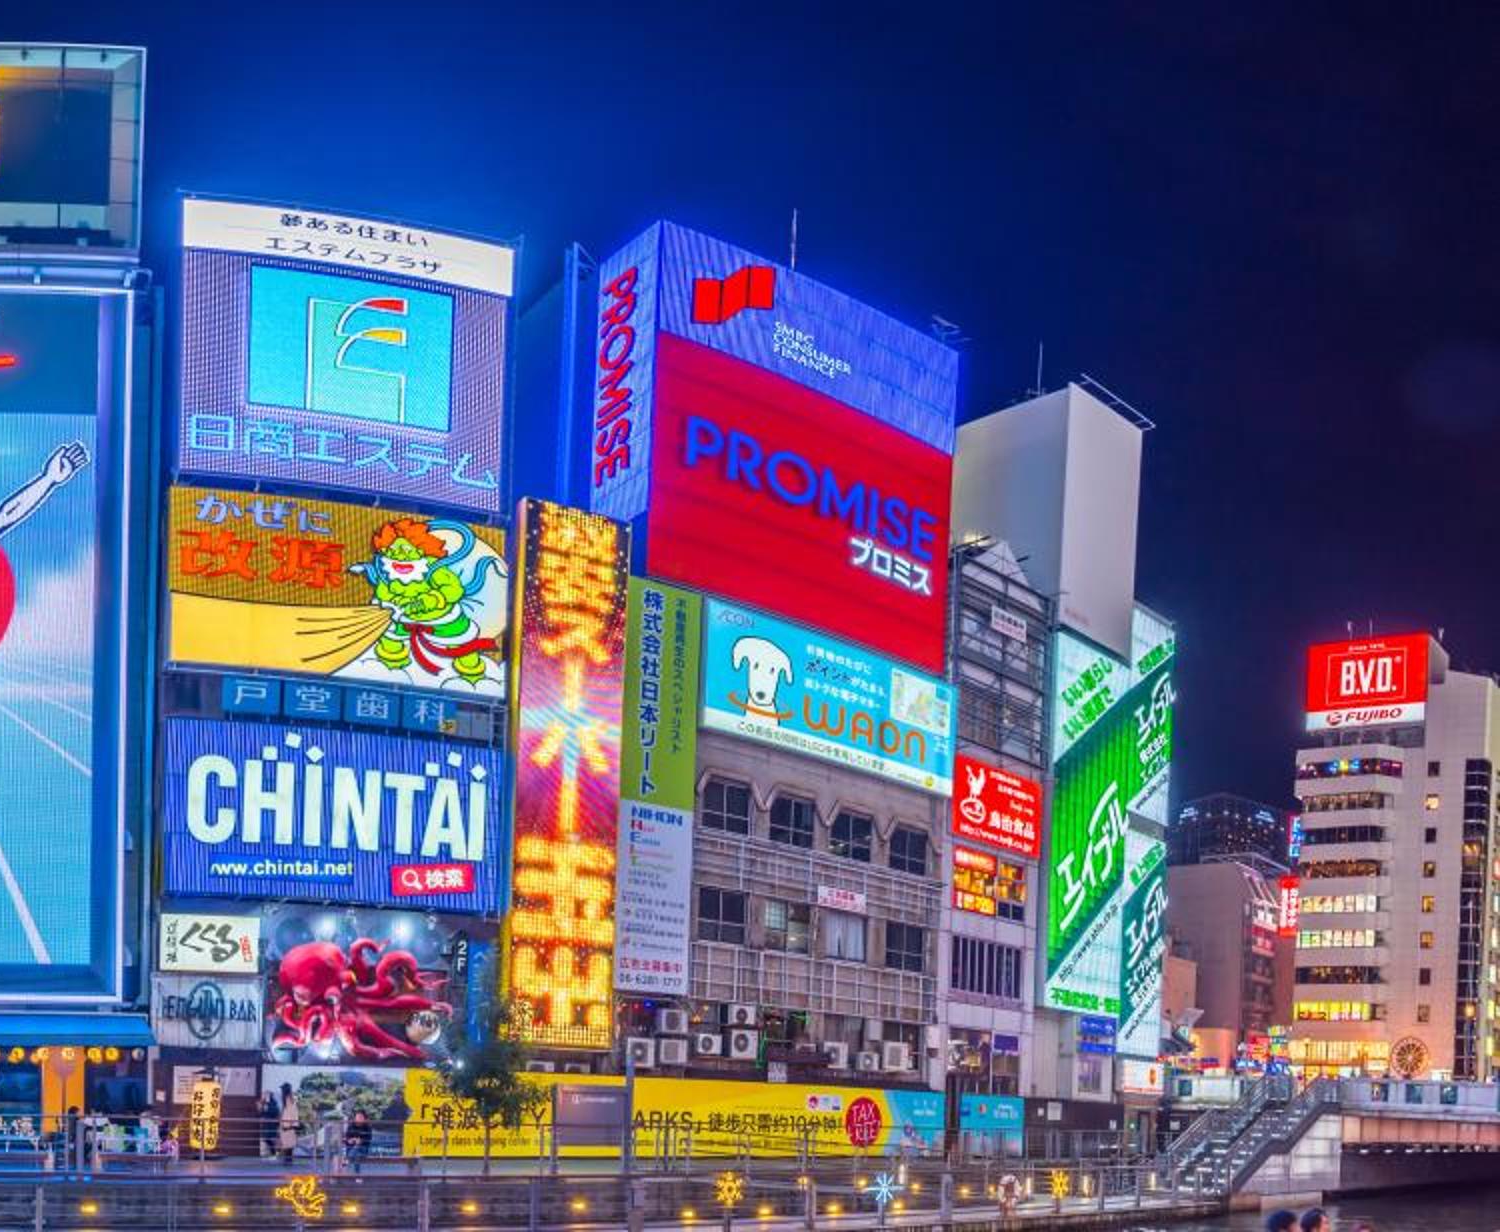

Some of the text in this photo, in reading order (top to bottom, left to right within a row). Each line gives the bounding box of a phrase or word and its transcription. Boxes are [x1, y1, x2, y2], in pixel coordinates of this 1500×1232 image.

[595, 266, 639, 487] PROMISE
[196, 495, 334, 535] かぜに
[684, 416, 939, 562] PROMISE
[179, 530, 345, 591] 改源
[848, 536, 932, 596] プロミス
[1340, 656, 1398, 697] B.V.D.
[803, 696, 926, 765] WAON
[1056, 780, 1130, 931] エイブル
